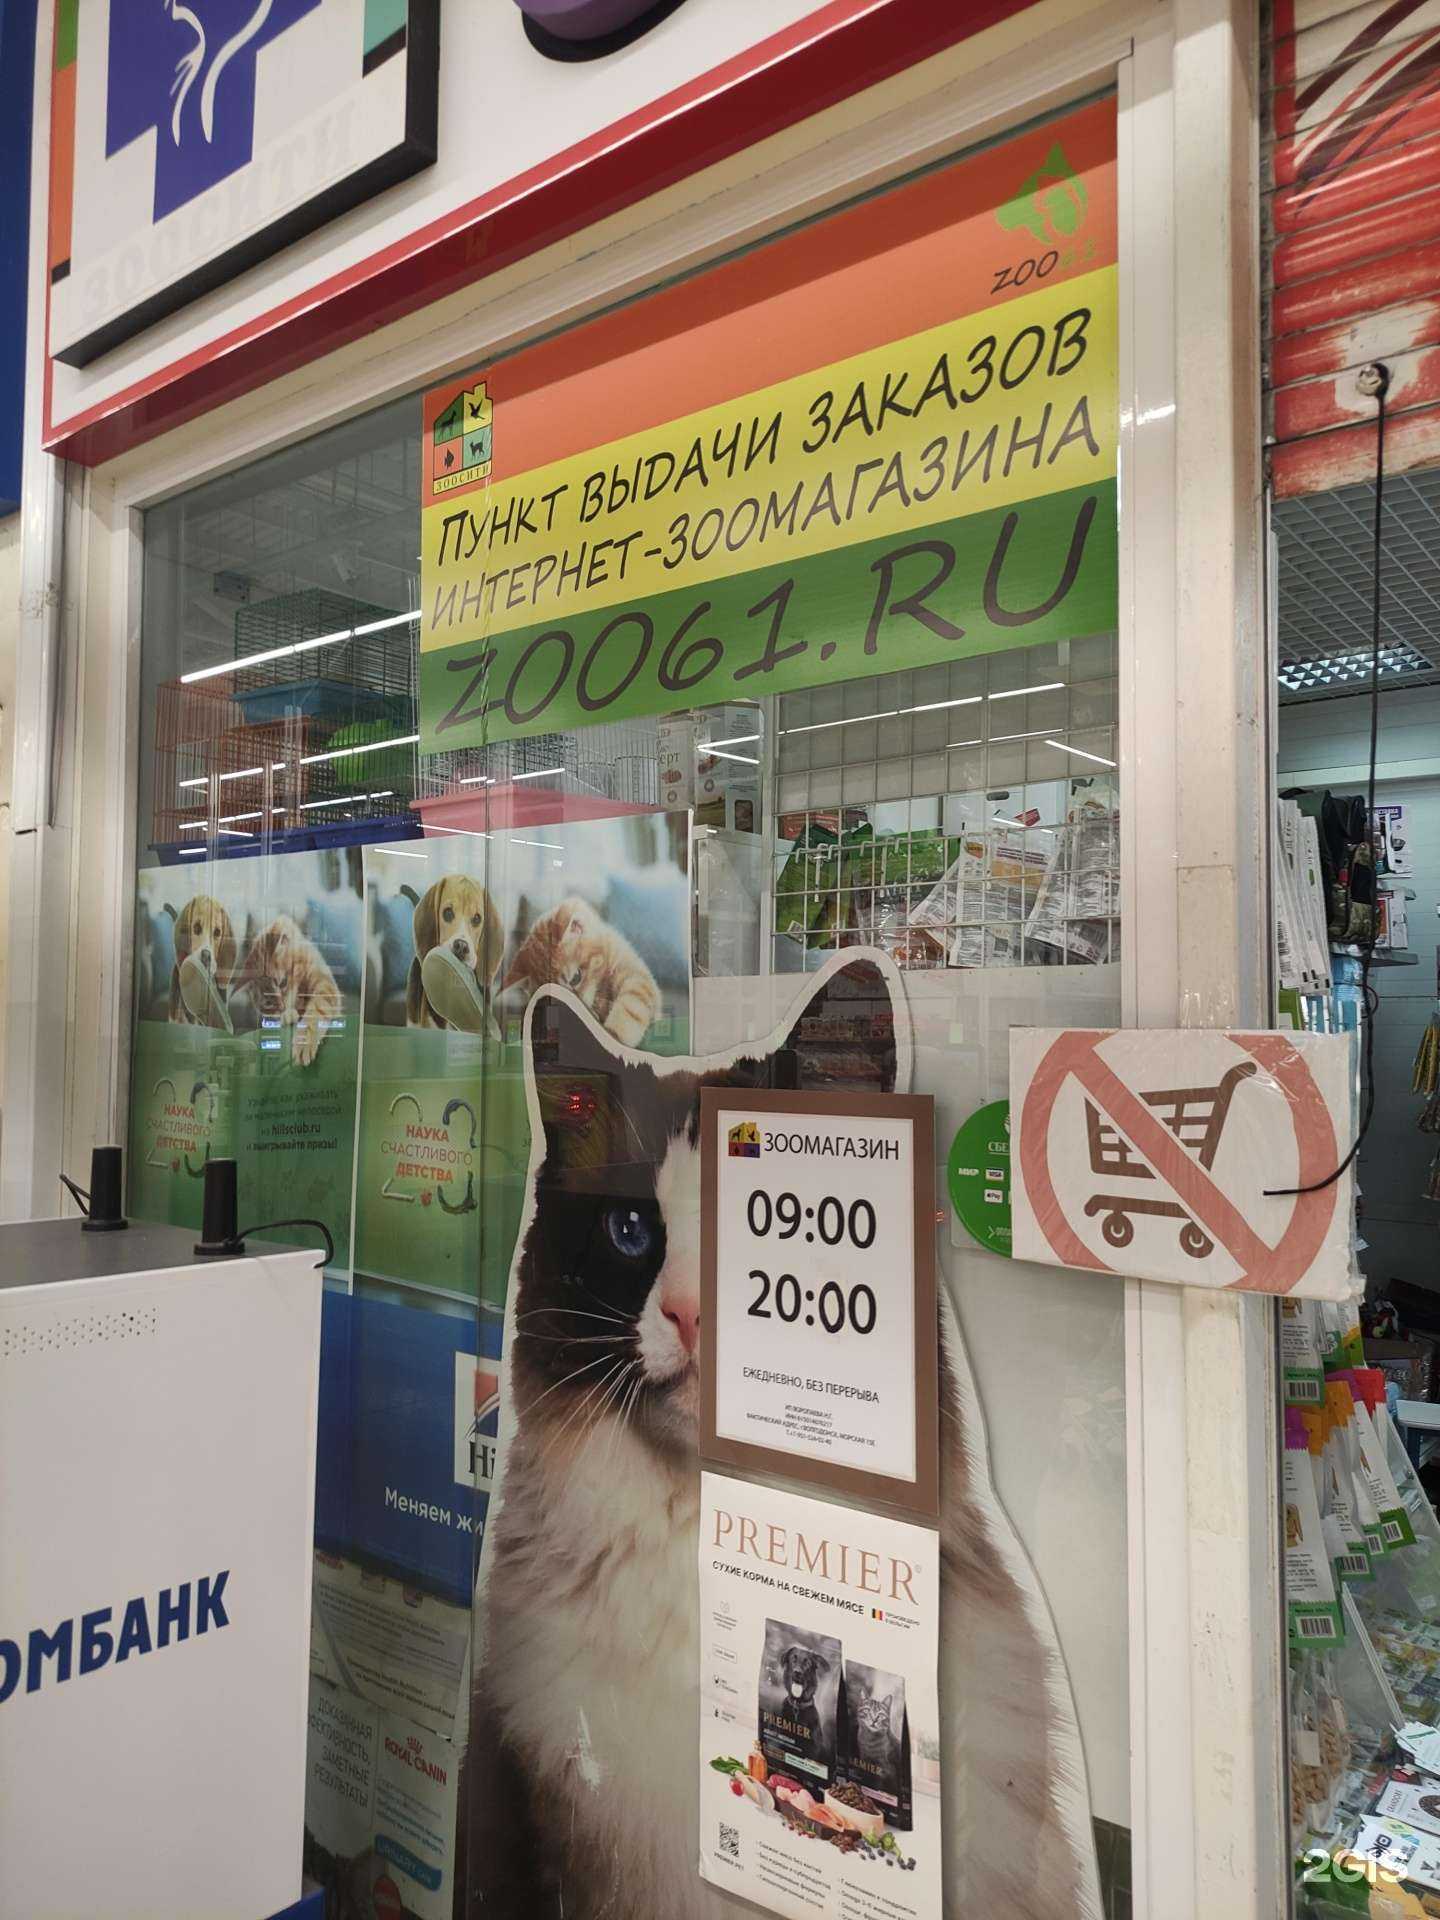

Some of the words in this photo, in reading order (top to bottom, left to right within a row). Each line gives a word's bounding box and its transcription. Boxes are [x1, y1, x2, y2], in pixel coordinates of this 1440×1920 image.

[437, 482, 568, 567] ПУНКТ
[577, 410, 784, 525] ВЫДАЧИ
[801, 306, 1093, 453] ЗАКАЗОВ
[436, 465, 490, 492] ЗООСИТИ
[430, 394, 1100, 630] ИНТЕРНЕТ-ЗООМАГАЗИНА
[436, 496, 1099, 736] ZOO61.RU
[381, 1141, 473, 1166] СЧАСТЛИВОГО
[406, 1124, 449, 1142] НАУКА
[763, 1132, 900, 1161] ЗООМАГАЗИН
[396, 1162, 454, 1182] ДЕТСТВА
[747, 1189, 877, 1249] 09:00
[747, 1269, 877, 1335] 20:00
[743, 1366, 805, 1390] ЕЖЕДНЕВНО,
[806, 1379, 824, 1392] БЕЗ
[825, 1383, 880, 1403] ПЕРЕРЫВА
[385, 1486, 451, 1526] Меняем
[712, 1509, 919, 1606] PREMIER
[712, 1560, 742, 1577] СУХИЕ
[742, 1568, 776, 1588] КОРМА
[777, 1580, 791, 1592] НА
[791, 1584, 835, 1606] СВЕЖЕМ
[835, 1598, 865, 1615] МЯСЕ
[763, 1711, 812, 1740] PREMIER
[384, 1736, 414, 1766] ROYAL
[414, 1757, 447, 1786] CANIN
